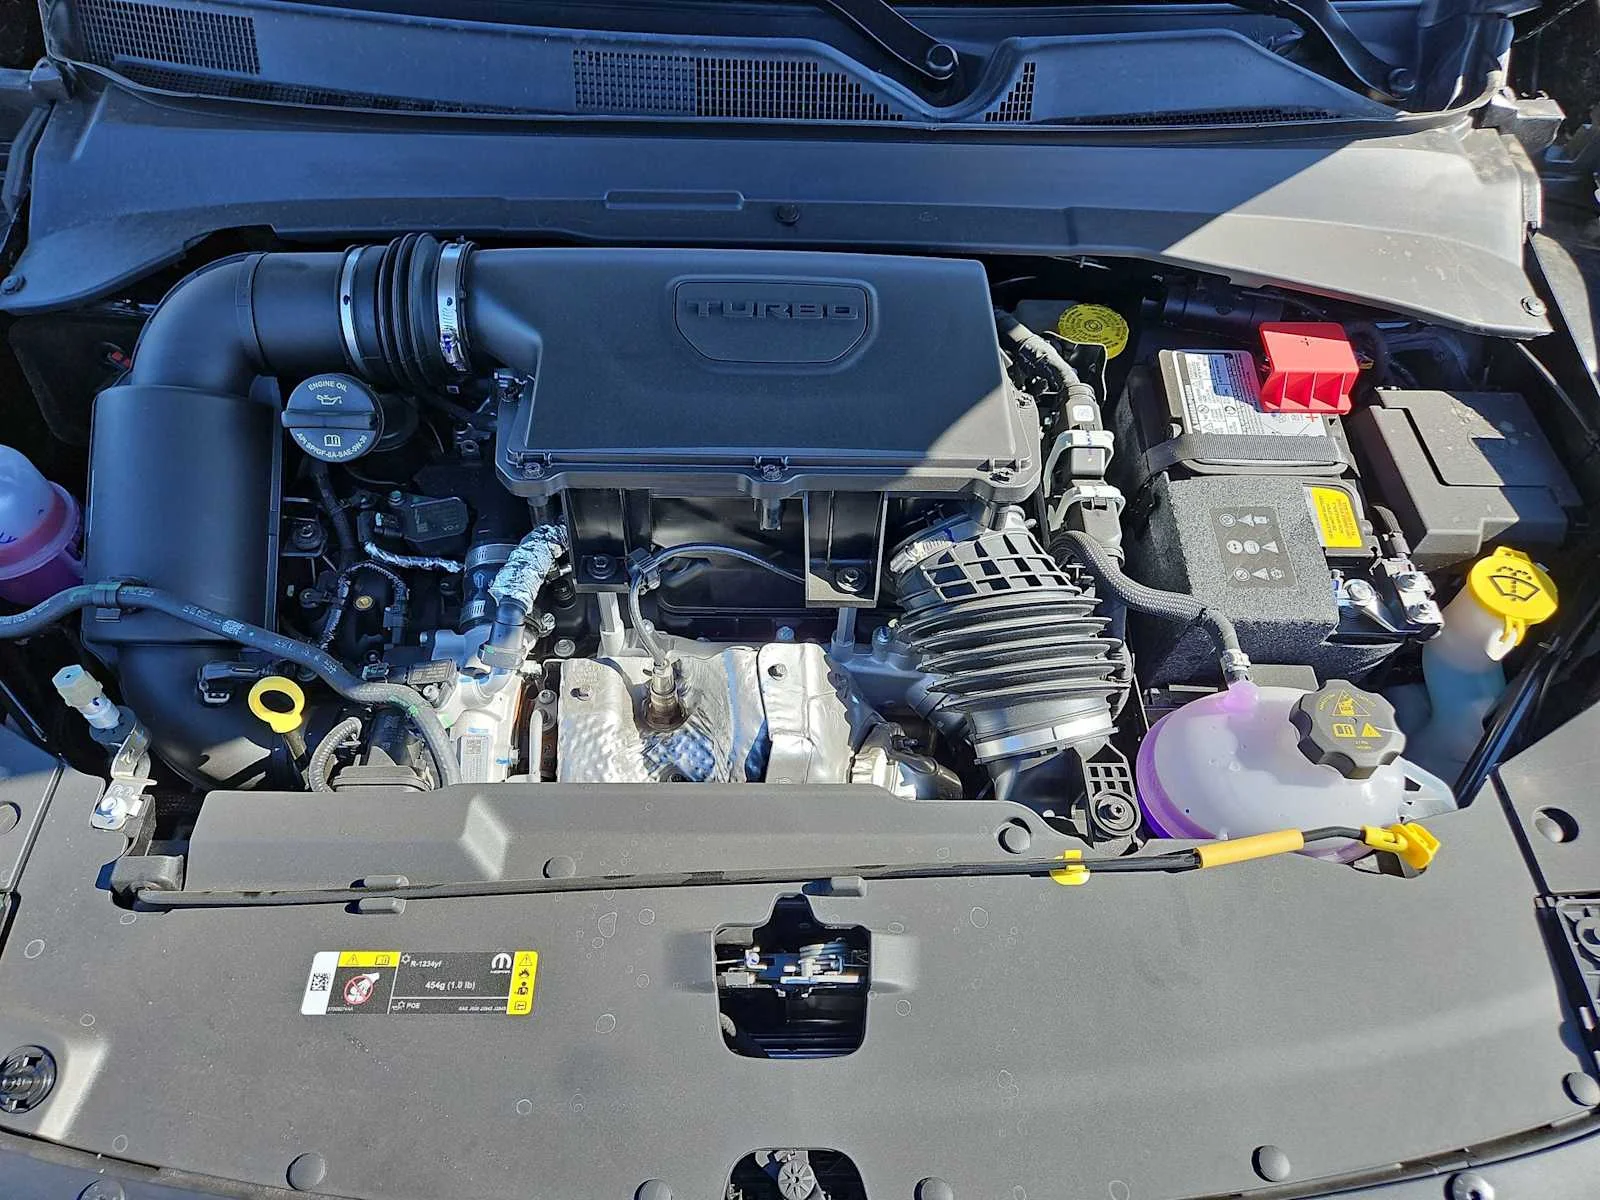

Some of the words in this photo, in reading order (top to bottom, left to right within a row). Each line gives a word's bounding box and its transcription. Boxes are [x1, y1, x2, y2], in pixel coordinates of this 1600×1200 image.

[686, 299, 859, 320] TURBO
[308, 380, 335, 391] ENGINE
[336, 382, 348, 392] OIL
[410, 960, 442, 969] R-1234yf
[425, 981, 446, 990] 454g
